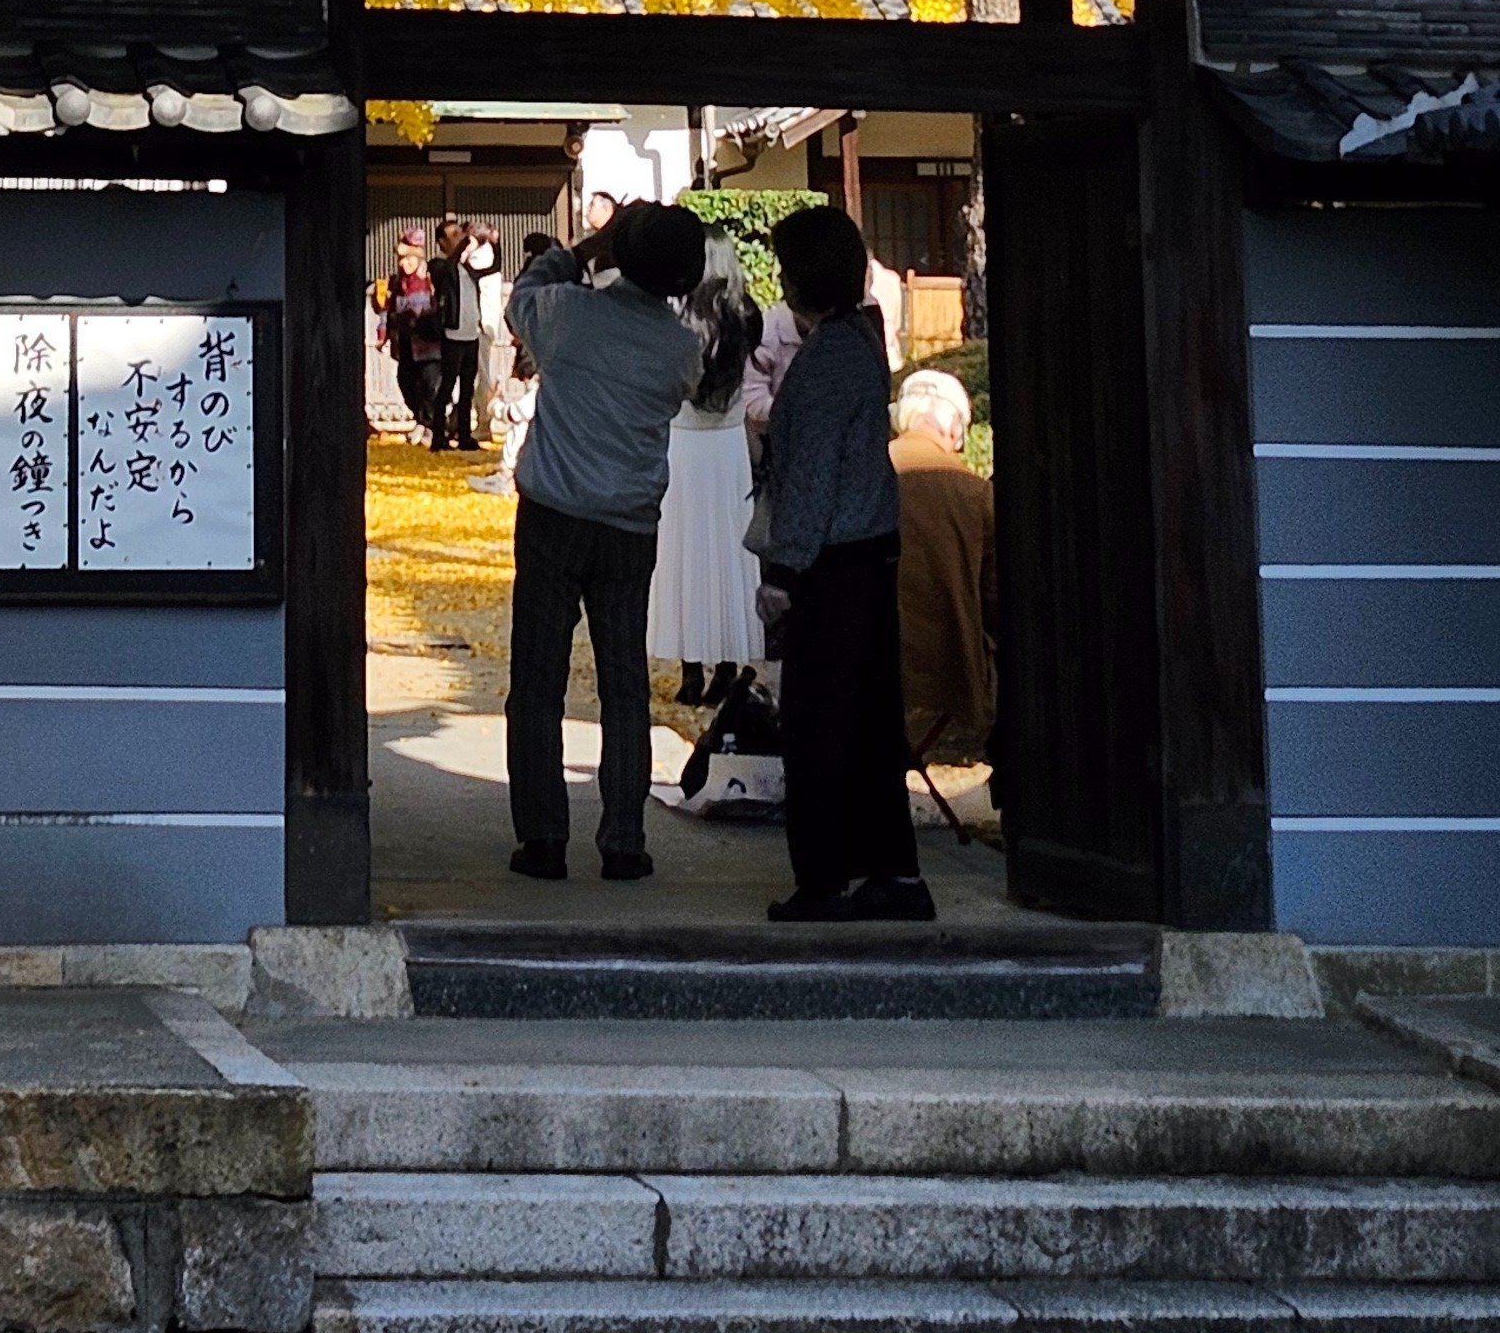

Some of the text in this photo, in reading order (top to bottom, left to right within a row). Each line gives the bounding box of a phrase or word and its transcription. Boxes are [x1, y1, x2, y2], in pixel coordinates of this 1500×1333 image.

[9, 333, 56, 551] 除夜の鐘つき
[122, 360, 158, 493] 不安定
[166, 372, 198, 524] するから
[199, 331, 237, 453] 背のび
[87, 410, 116, 549] なんだよ
